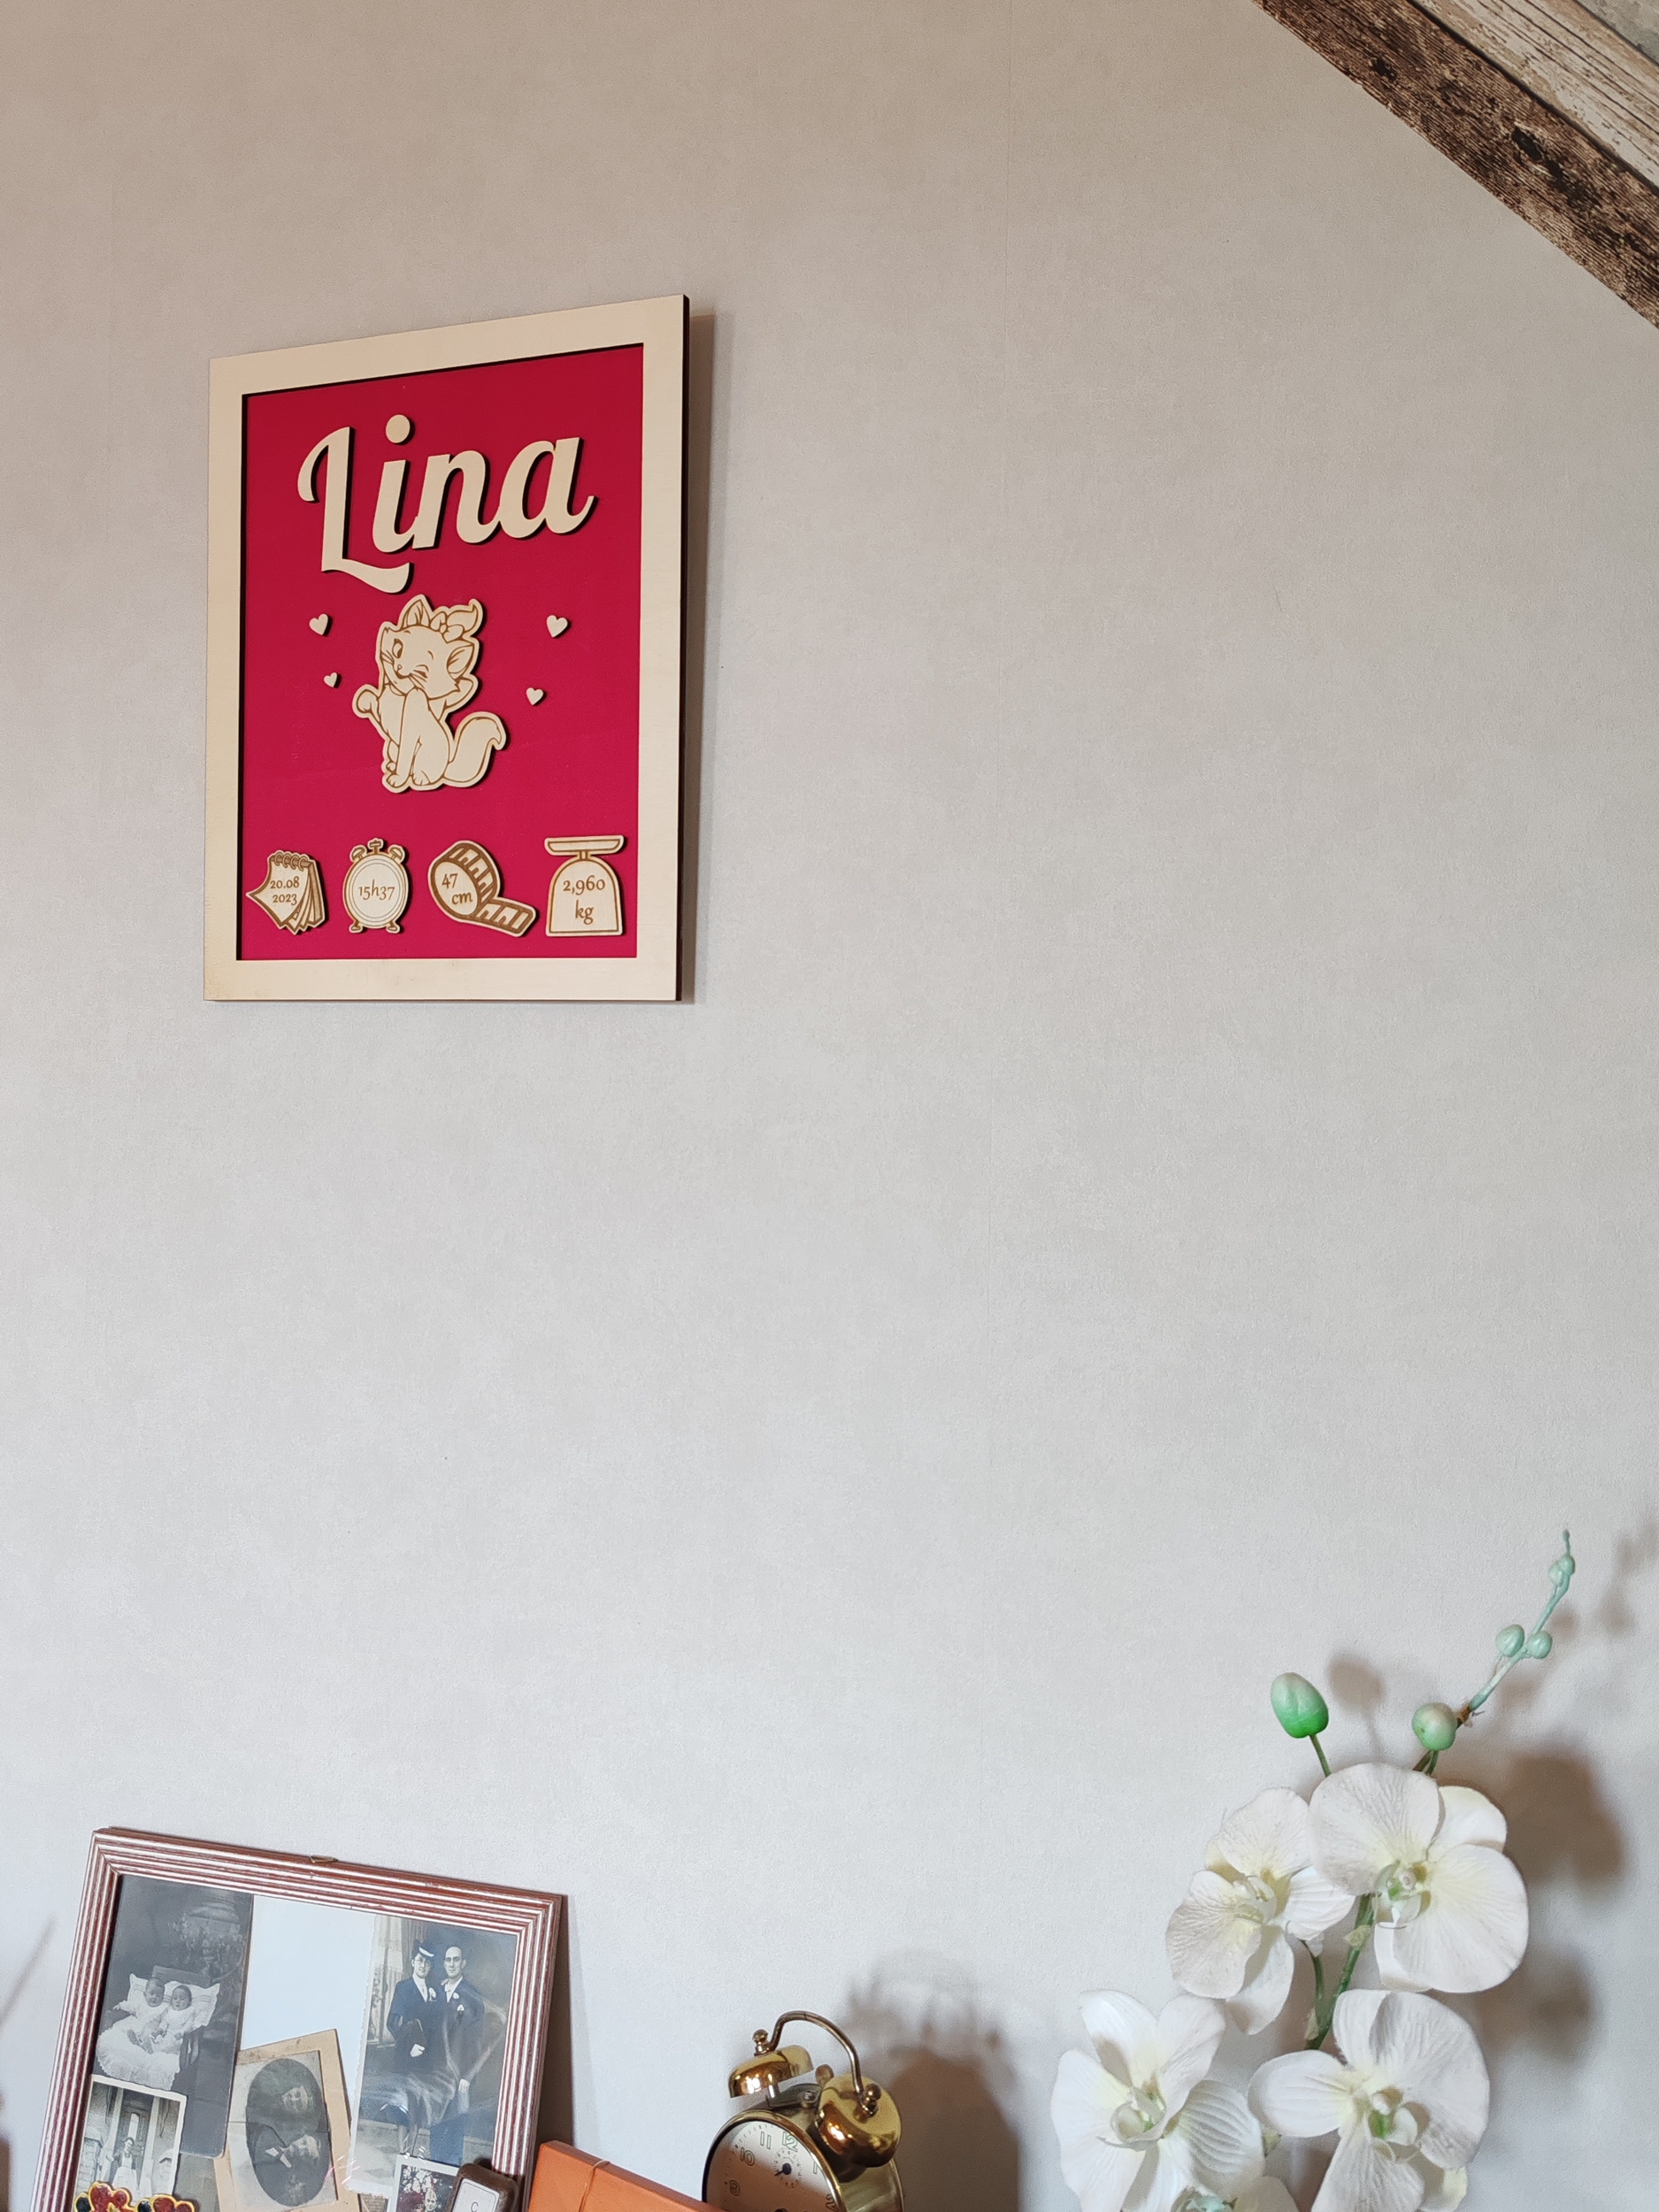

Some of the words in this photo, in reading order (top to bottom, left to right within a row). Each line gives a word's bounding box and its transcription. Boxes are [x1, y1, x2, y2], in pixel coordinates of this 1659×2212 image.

[297, 414, 595, 594] Lina
[270, 876, 300, 889] 20.08
[357, 879, 396, 901] 15h37
[442, 873, 458, 888] 47
[563, 875, 605, 895] 2,960
[272, 894, 298, 905] 2023
[451, 892, 473, 905] cm
[574, 900, 594, 925] kg
[759, 2131, 772, 2150] 11
[781, 2131, 798, 2153] 12
[740, 2147, 756, 2166] 10
[729, 2179, 741, 2196] 9
